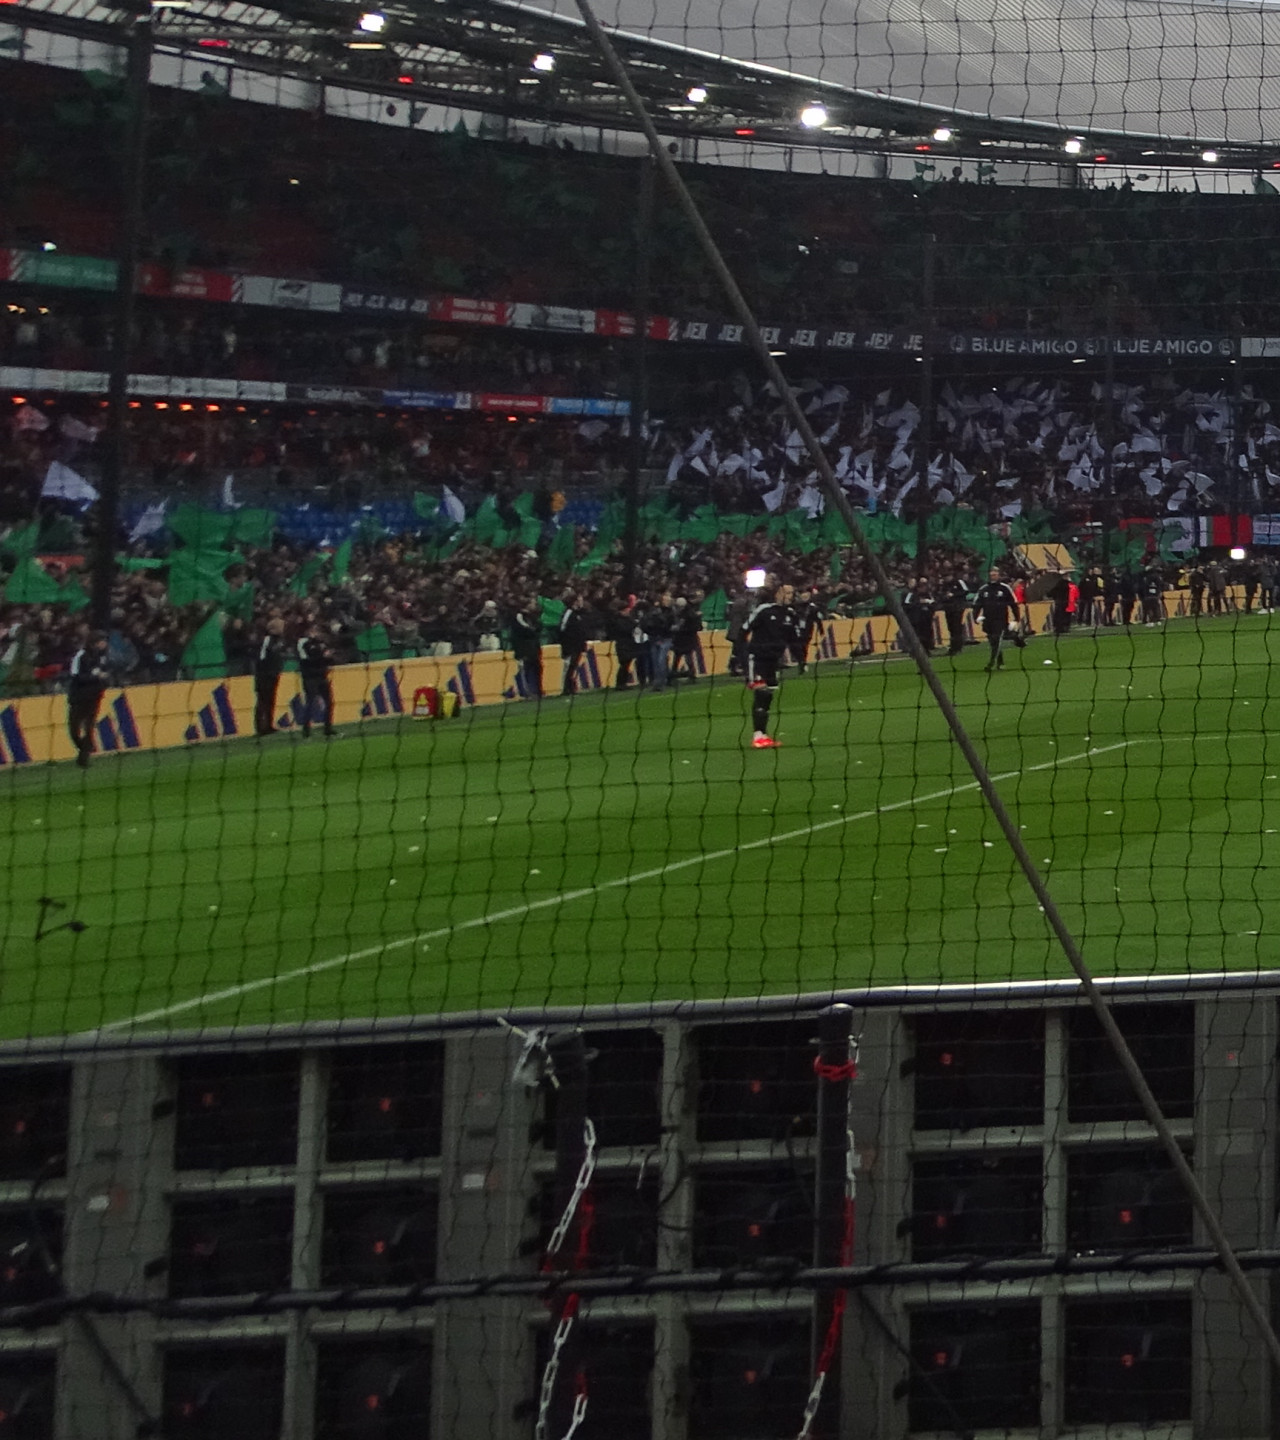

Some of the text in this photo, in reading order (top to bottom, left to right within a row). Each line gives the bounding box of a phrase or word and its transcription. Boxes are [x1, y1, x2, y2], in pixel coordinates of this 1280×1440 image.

[790, 329, 818, 347] JEX
[826, 331, 857, 348] JEX
[903, 334, 923, 351] JE
[972, 337, 1078, 354] BLUE AMIGO
[1113, 339, 1213, 355] LUE AMIGO
